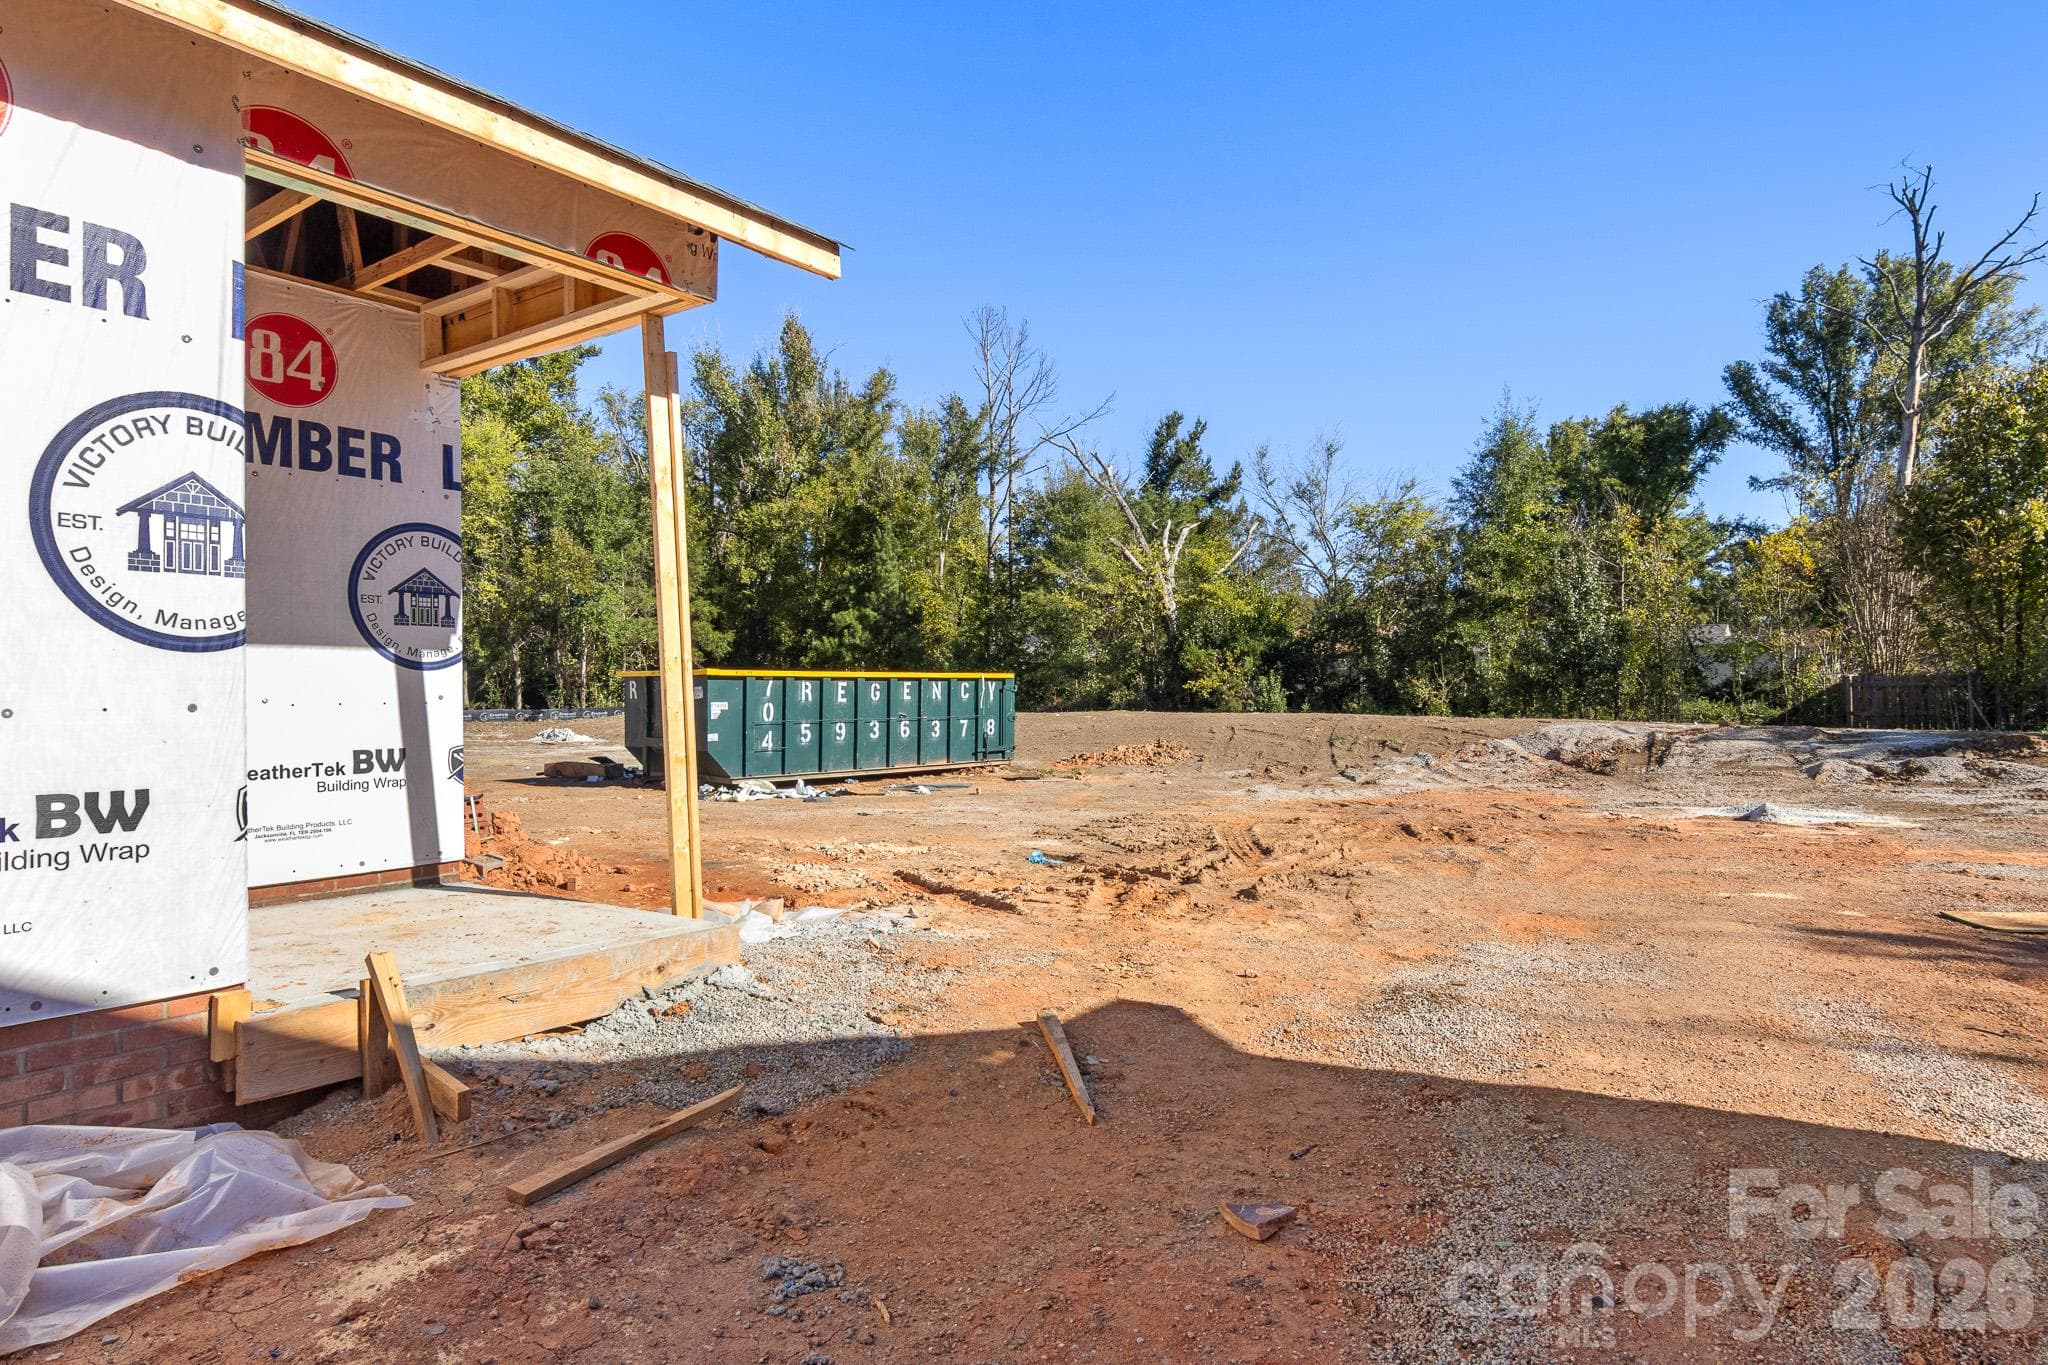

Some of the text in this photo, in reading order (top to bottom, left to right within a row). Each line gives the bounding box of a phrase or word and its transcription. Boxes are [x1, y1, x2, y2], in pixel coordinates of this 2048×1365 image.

[250, 328, 326, 392] 84
[63, 414, 171, 490] VICTORY
[57, 512, 104, 532] EST.
[363, 536, 414, 582] VICTORY
[69, 546, 142, 620] Design,
[360, 593, 383, 605] EST.
[801, 680, 996, 703] REGENCY
[247, 748, 406, 781] eatherTek BW
[317, 777, 407, 793] Building Wrap
[35, 789, 150, 840] BW
[276, 823, 304, 832] Building
[338, 818, 353, 826] LLC
[79, 842, 150, 864] Wrap
[3, 921, 33, 935] LLC
